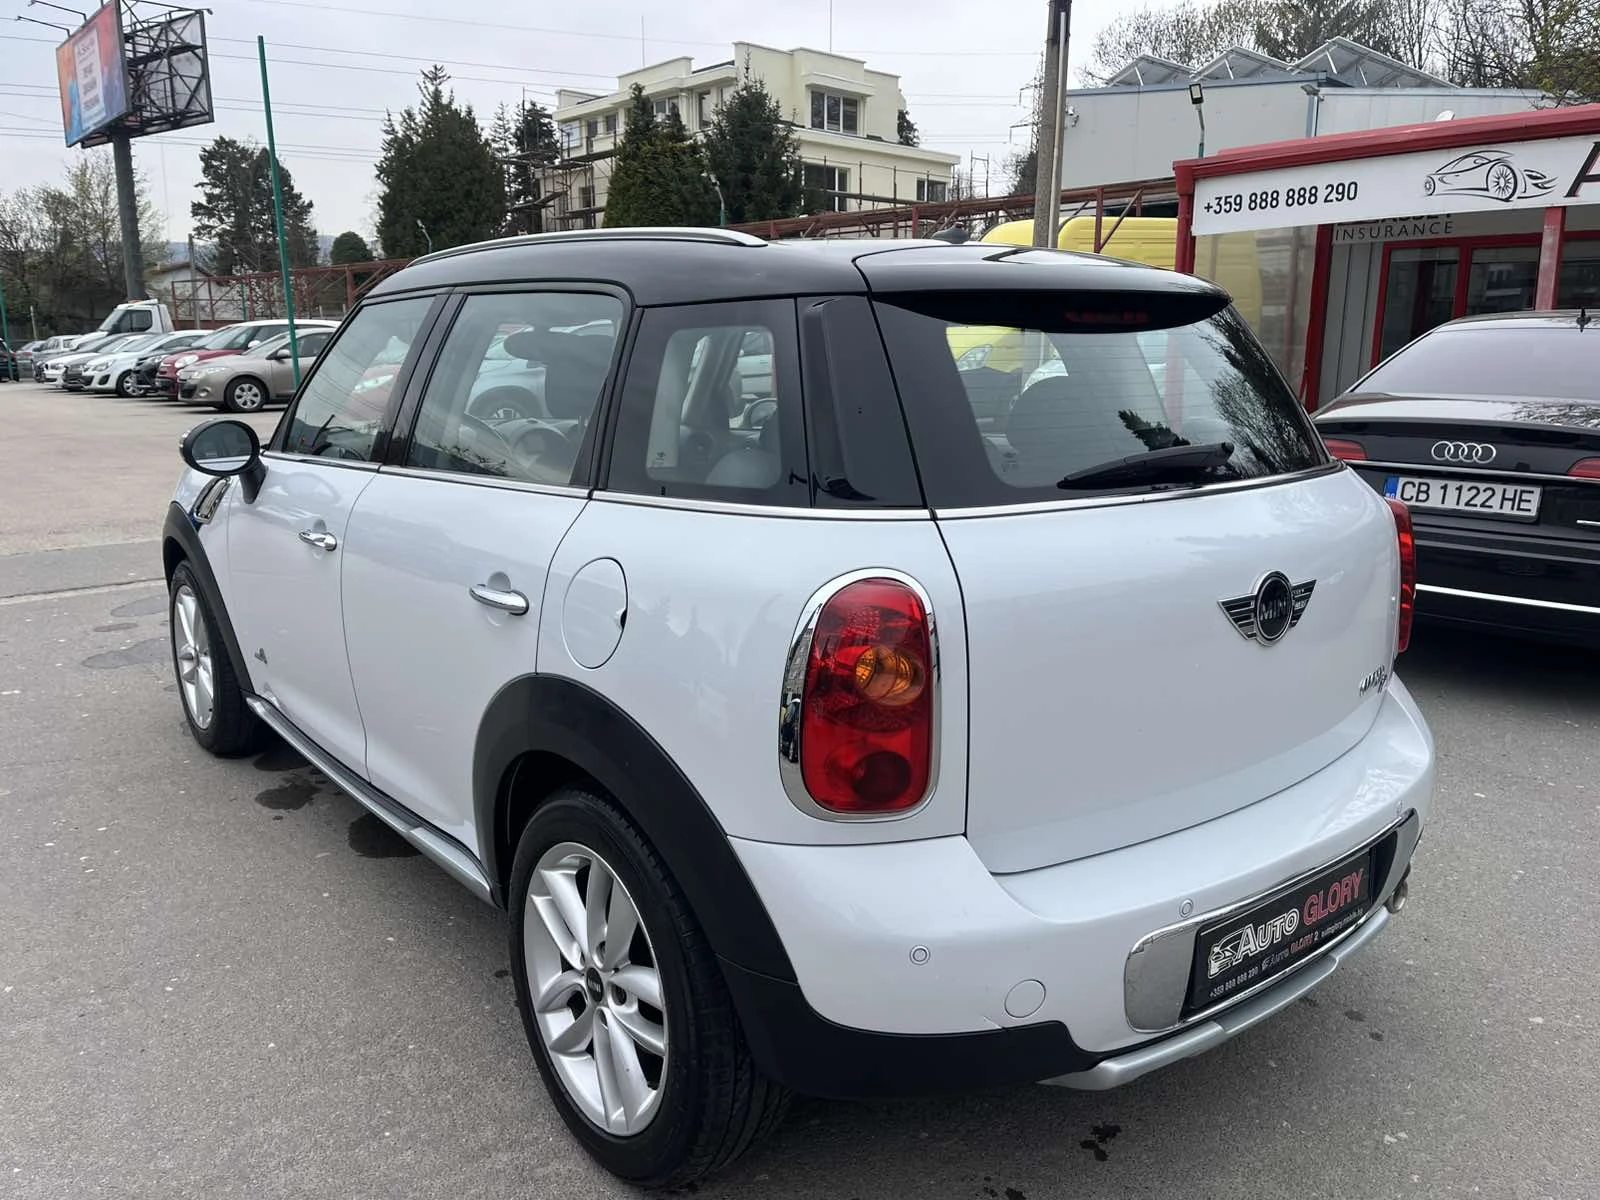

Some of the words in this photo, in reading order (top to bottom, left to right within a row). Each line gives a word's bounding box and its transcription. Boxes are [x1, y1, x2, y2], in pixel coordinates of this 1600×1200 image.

[1204, 194, 1243, 215] +359
[1248, 190, 1280, 211] 888
[1285, 185, 1318, 206] 888
[1323, 180, 1359, 203] 290
[1335, 221, 1454, 241] INSURANCE
[1400, 480, 1430, 503] CB
[1440, 483, 1496, 509] 1122
[1499, 489, 1535, 512] HE
[1303, 867, 1364, 926] GLORY
